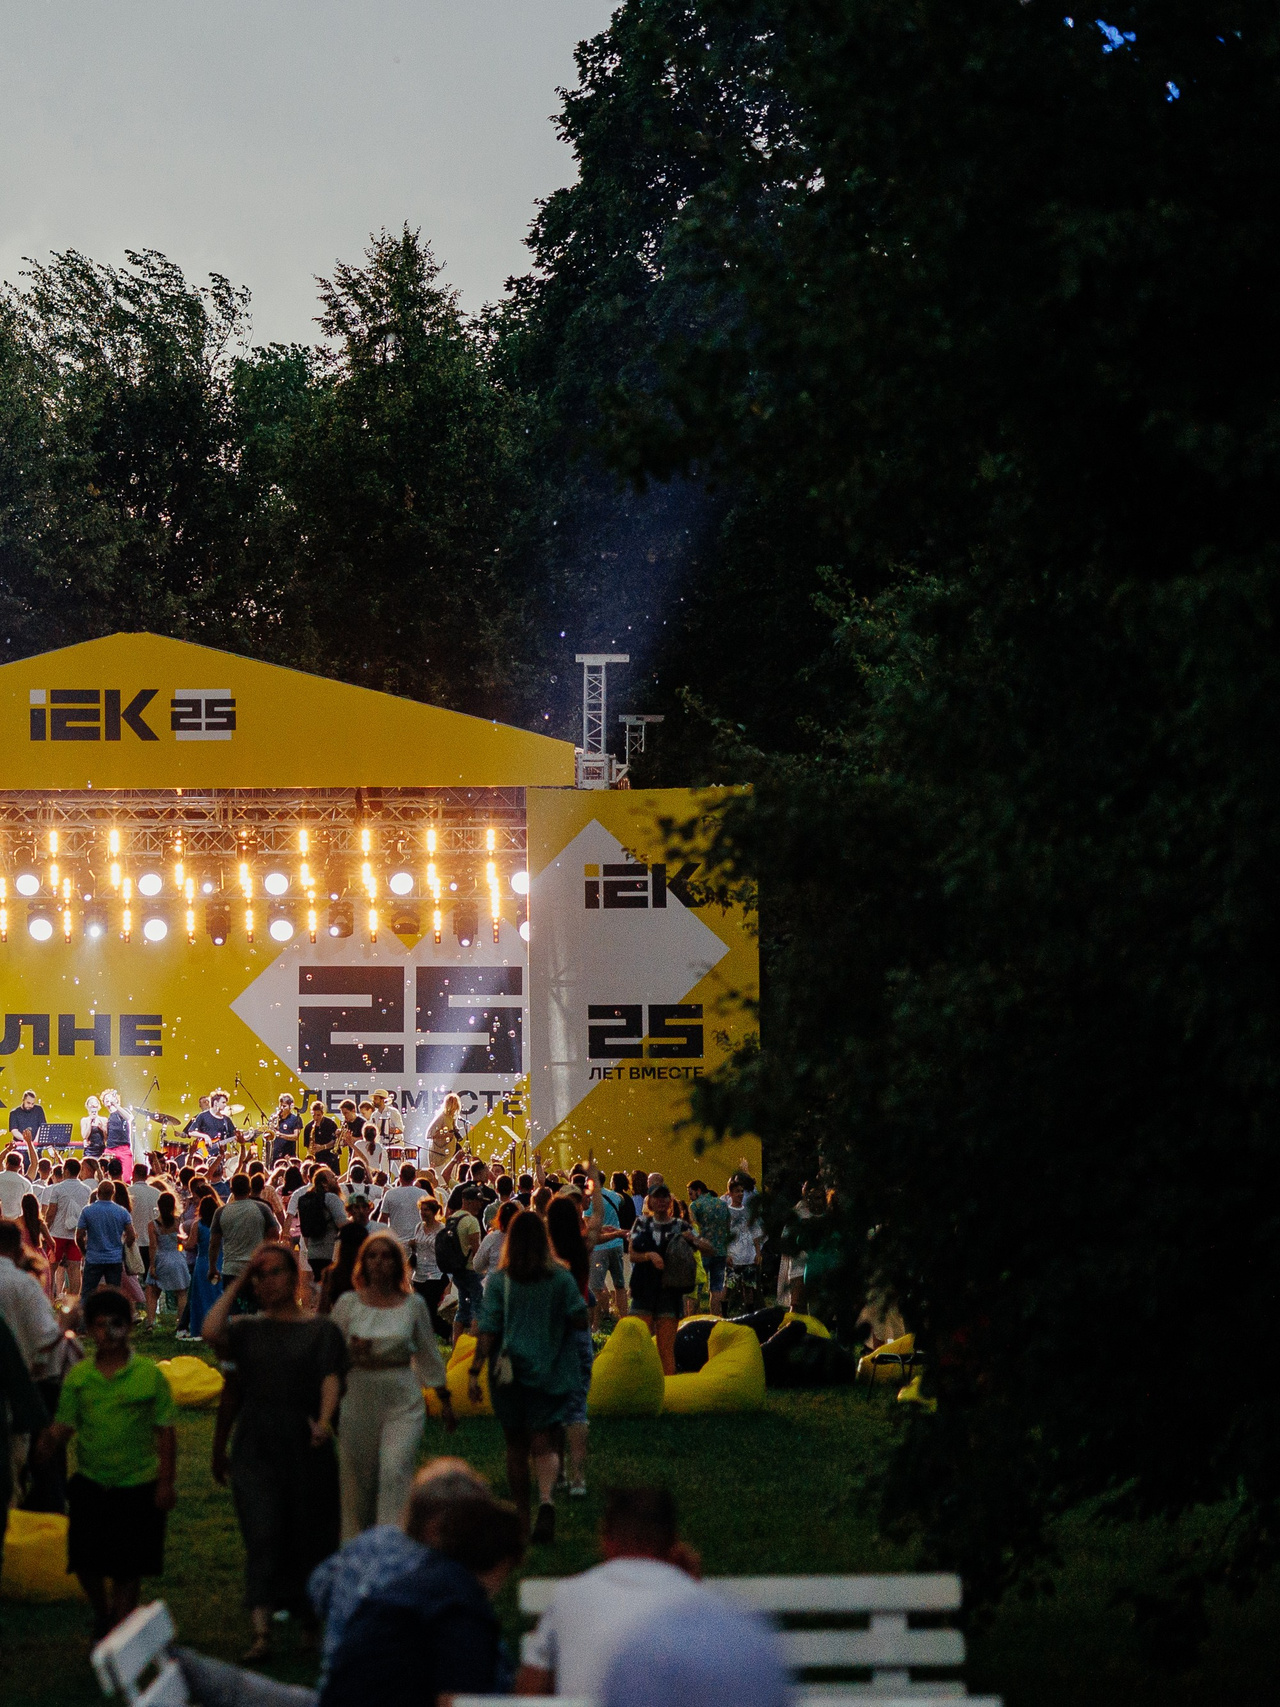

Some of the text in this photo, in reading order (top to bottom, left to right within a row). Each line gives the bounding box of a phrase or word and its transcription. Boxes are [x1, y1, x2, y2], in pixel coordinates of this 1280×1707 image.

[170, 698, 237, 731] 25
[298, 966, 523, 1074] 25
[588, 1004, 704, 1059] 25
[588, 1066, 705, 1080] ЛЕТ ВМЕСТЕ
